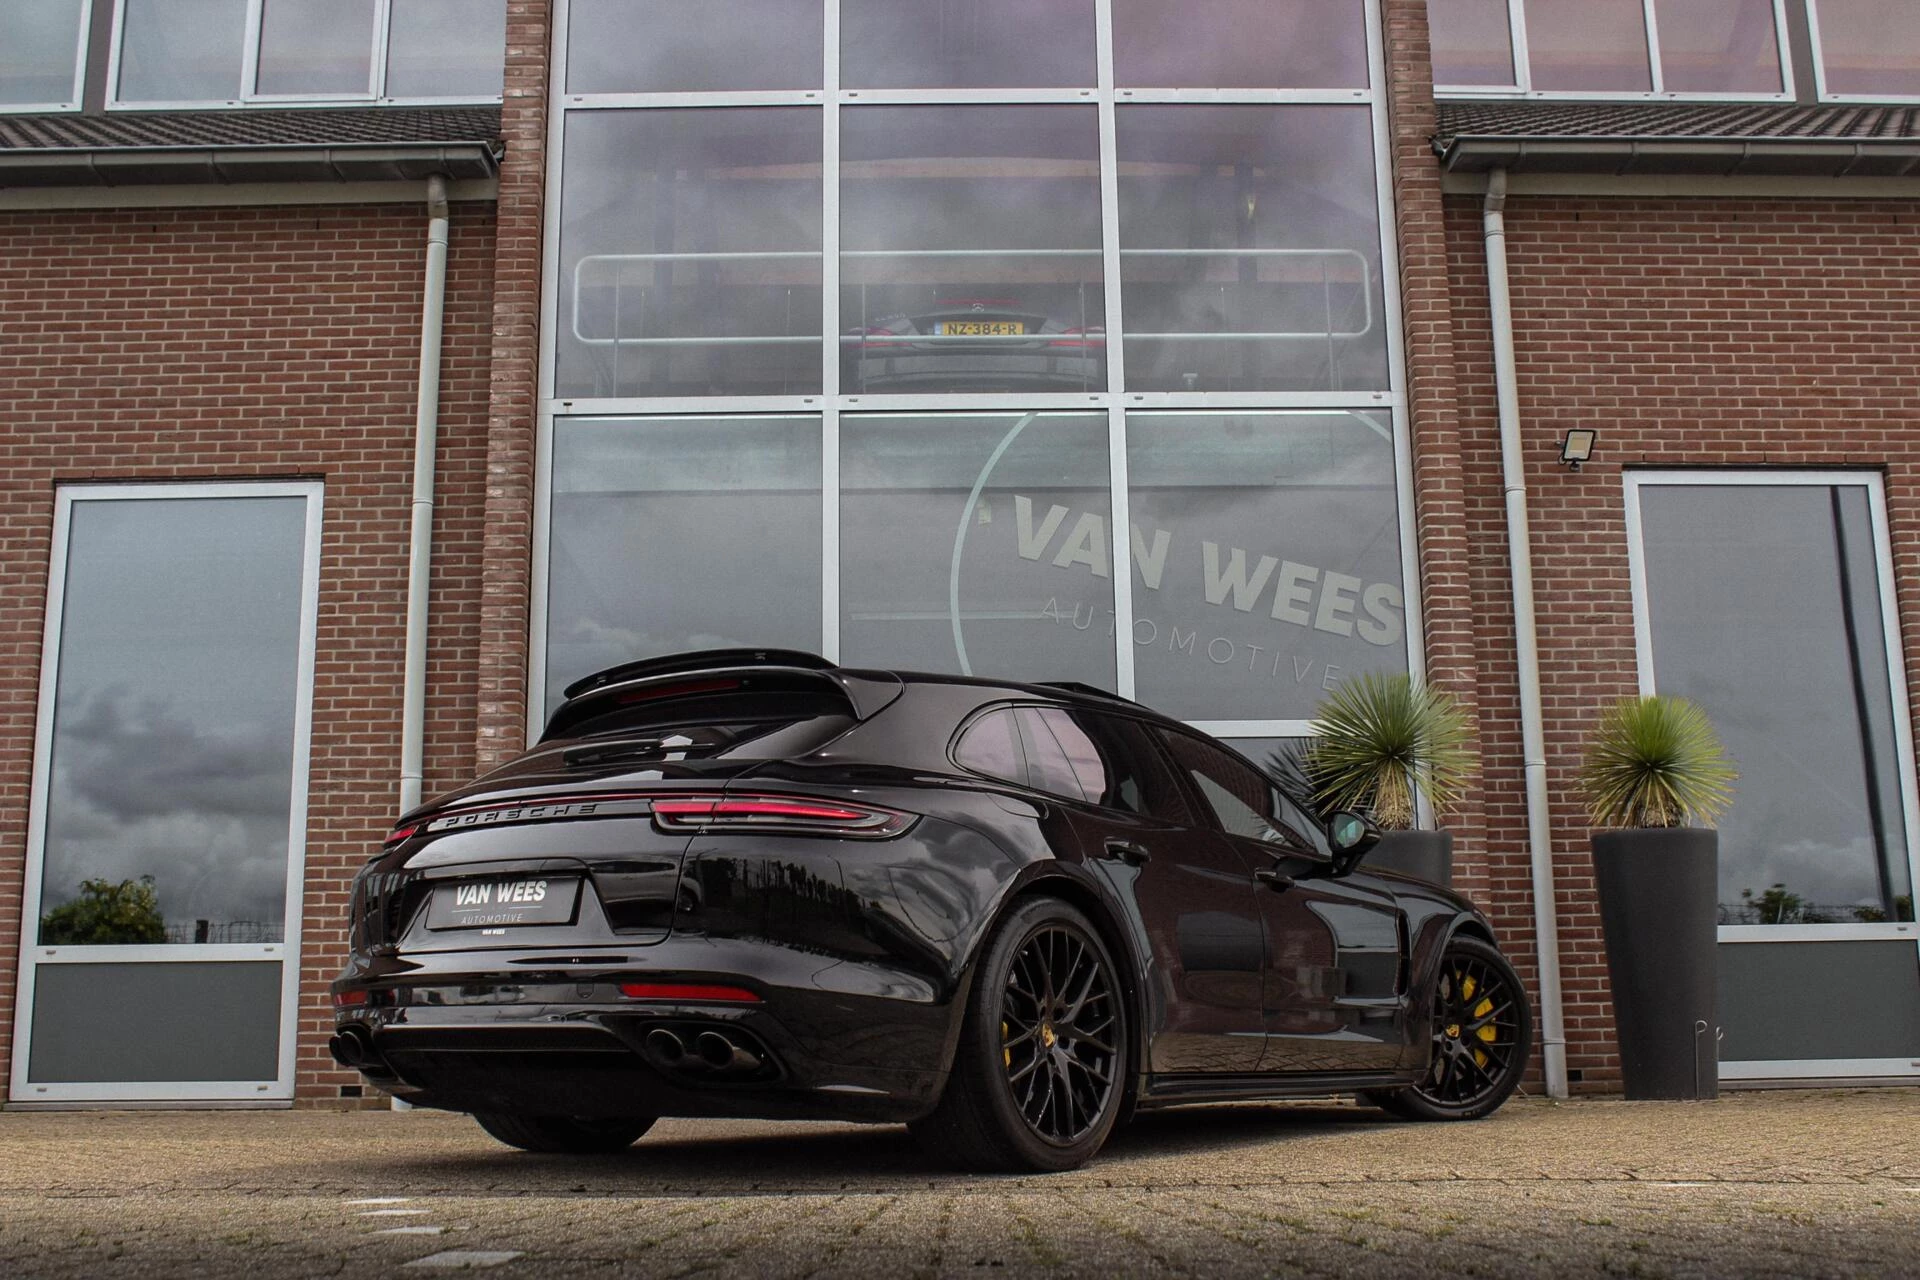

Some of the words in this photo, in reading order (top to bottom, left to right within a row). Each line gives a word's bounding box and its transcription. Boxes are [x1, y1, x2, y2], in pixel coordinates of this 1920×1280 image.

[947, 322, 1017, 336] NZ-384-R
[1014, 495, 1172, 590] VAN
[1202, 540, 1406, 646] WEES
[445, 803, 598, 828] PORSCHE
[456, 883, 492, 905] VAN
[497, 880, 547, 902] WEES
[461, 913, 523, 925] AUTOMOTIVE
